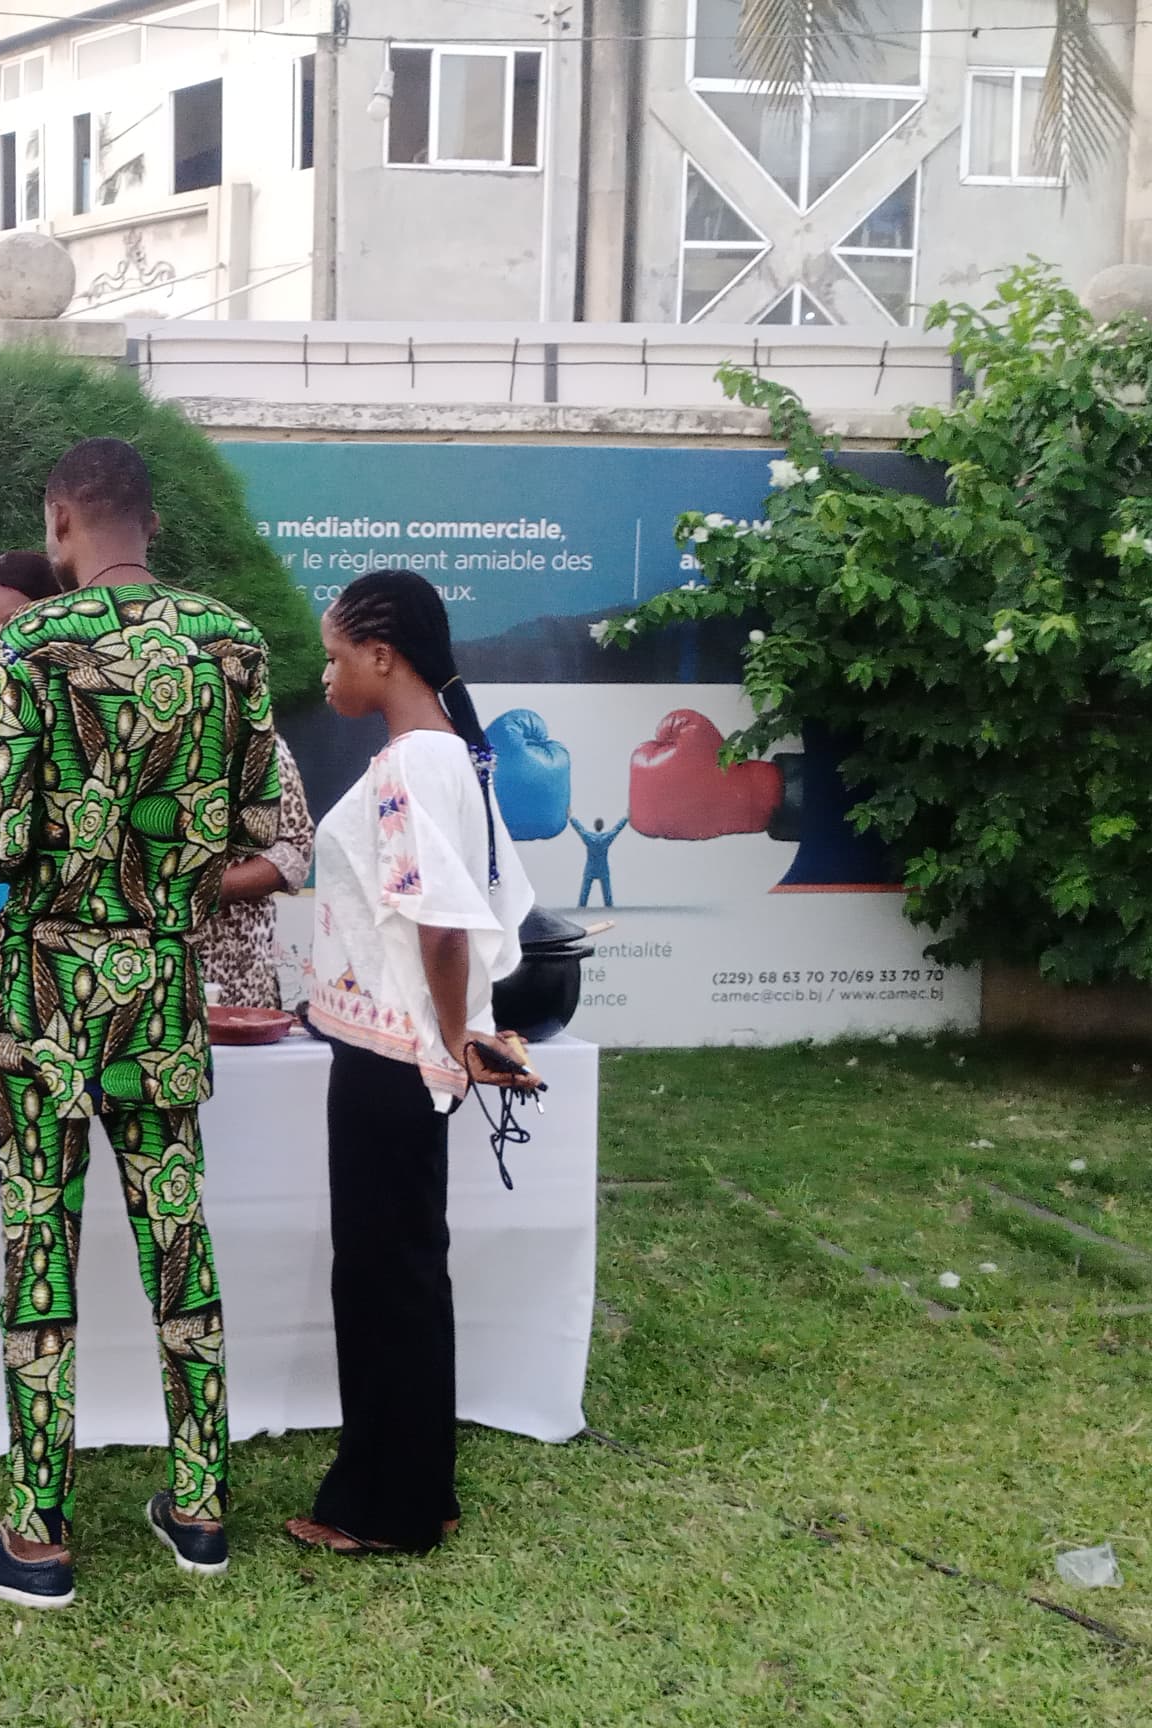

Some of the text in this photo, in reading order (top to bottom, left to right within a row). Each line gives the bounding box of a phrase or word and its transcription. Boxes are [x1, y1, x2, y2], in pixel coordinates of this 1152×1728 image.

[277, 516, 400, 539] médiation
[406, 517, 567, 543] commerciale,
[303, 549, 323, 570] le
[328, 549, 448, 574] règlement
[455, 550, 545, 571] amiable
[551, 550, 593, 571] des
[711, 970, 754, 986] (229)
[758, 970, 777, 984] 68
[782, 970, 801, 984] 63
[806, 970, 825, 984] 70
[879, 969, 897, 983] 33
[902, 969, 920, 983] 70
[925, 968, 944, 982] 70
[711, 988, 823, 1005] camec@ccib.bj
[839, 986, 945, 1002] www.camec.bj
